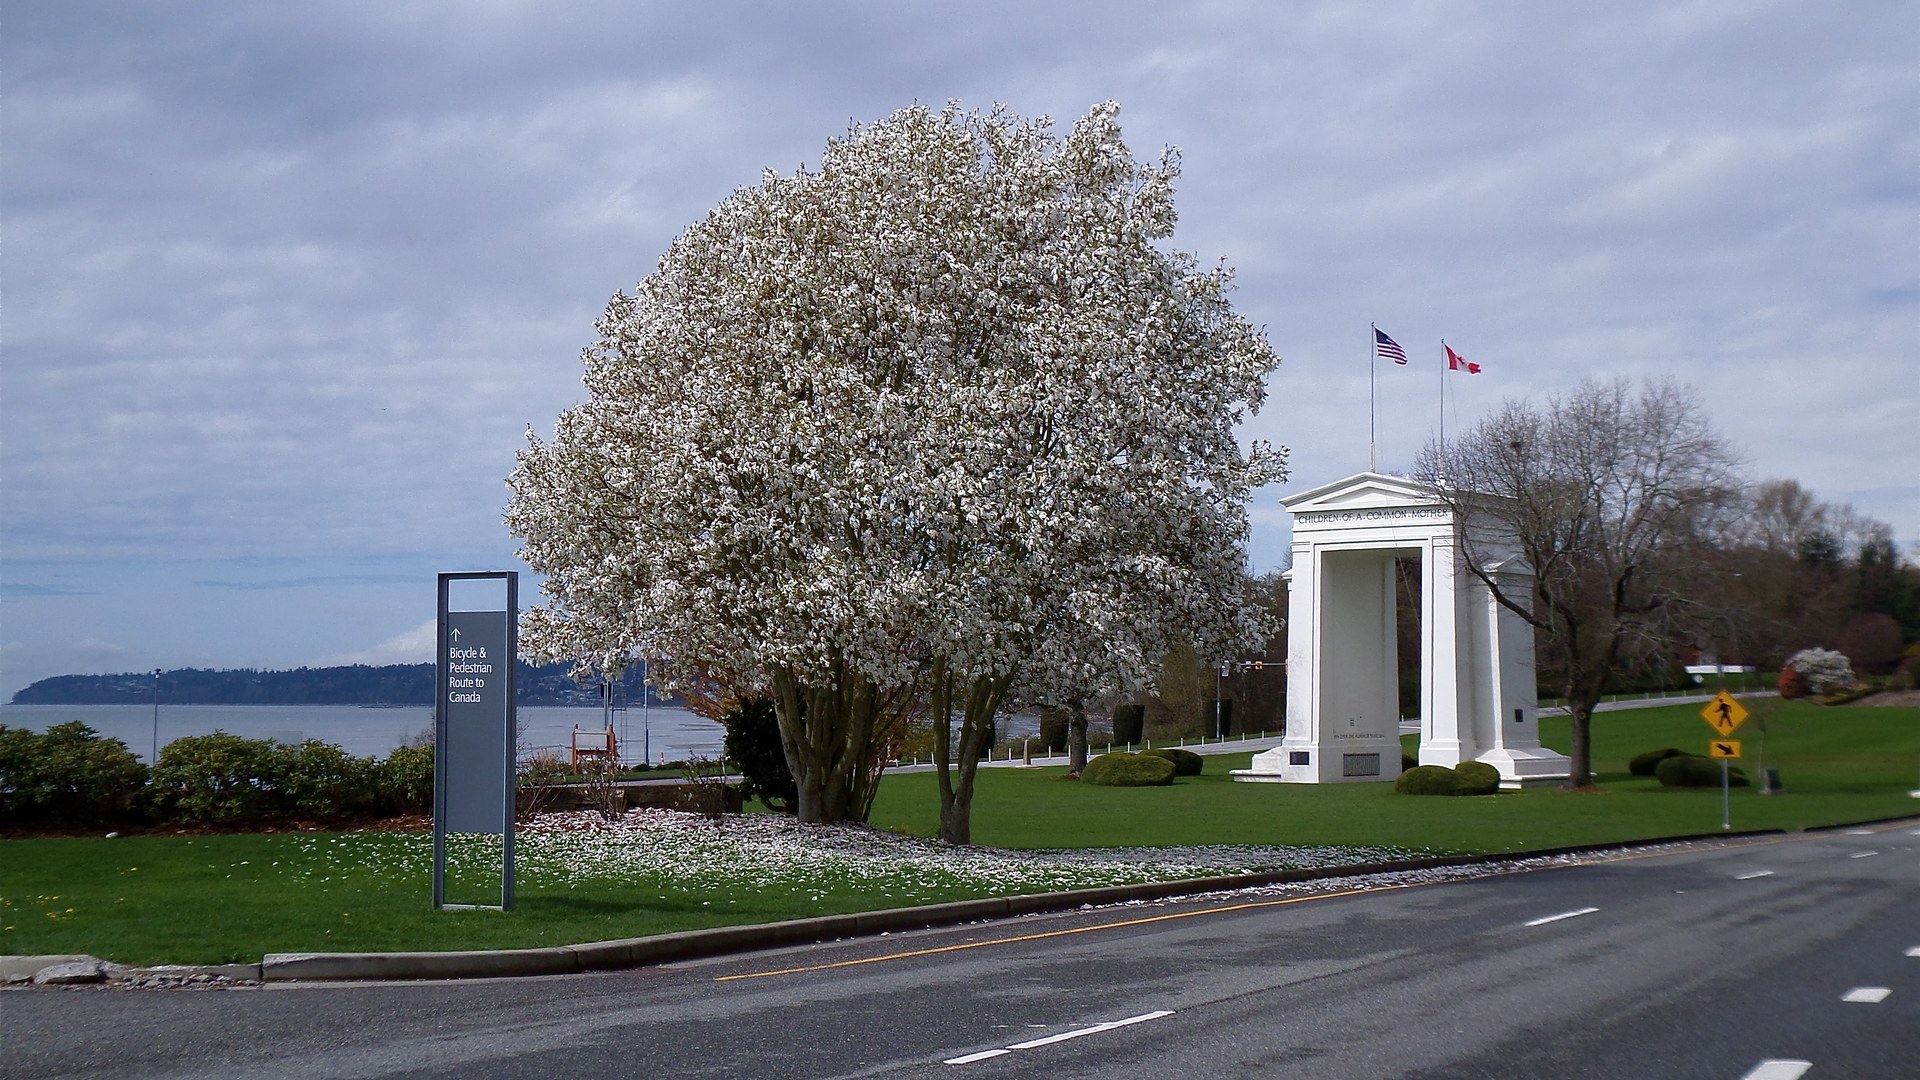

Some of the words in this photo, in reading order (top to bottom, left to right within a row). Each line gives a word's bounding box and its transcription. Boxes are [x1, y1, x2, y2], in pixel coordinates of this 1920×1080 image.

[1298, 513, 1339, 524] CHILDREN
[1342, 513, 1353, 522] OF
[1355, 512, 1363, 521] A
[1366, 510, 1407, 521] COMMON
[1411, 508, 1449, 519] MOTHER
[450, 647, 477, 661] Bicycle
[479, 647, 487, 658] &
[449, 662, 492, 673] Pedestrian
[449, 677, 474, 688] Route
[475, 677, 485, 688] to
[449, 691, 481, 703] Canada
